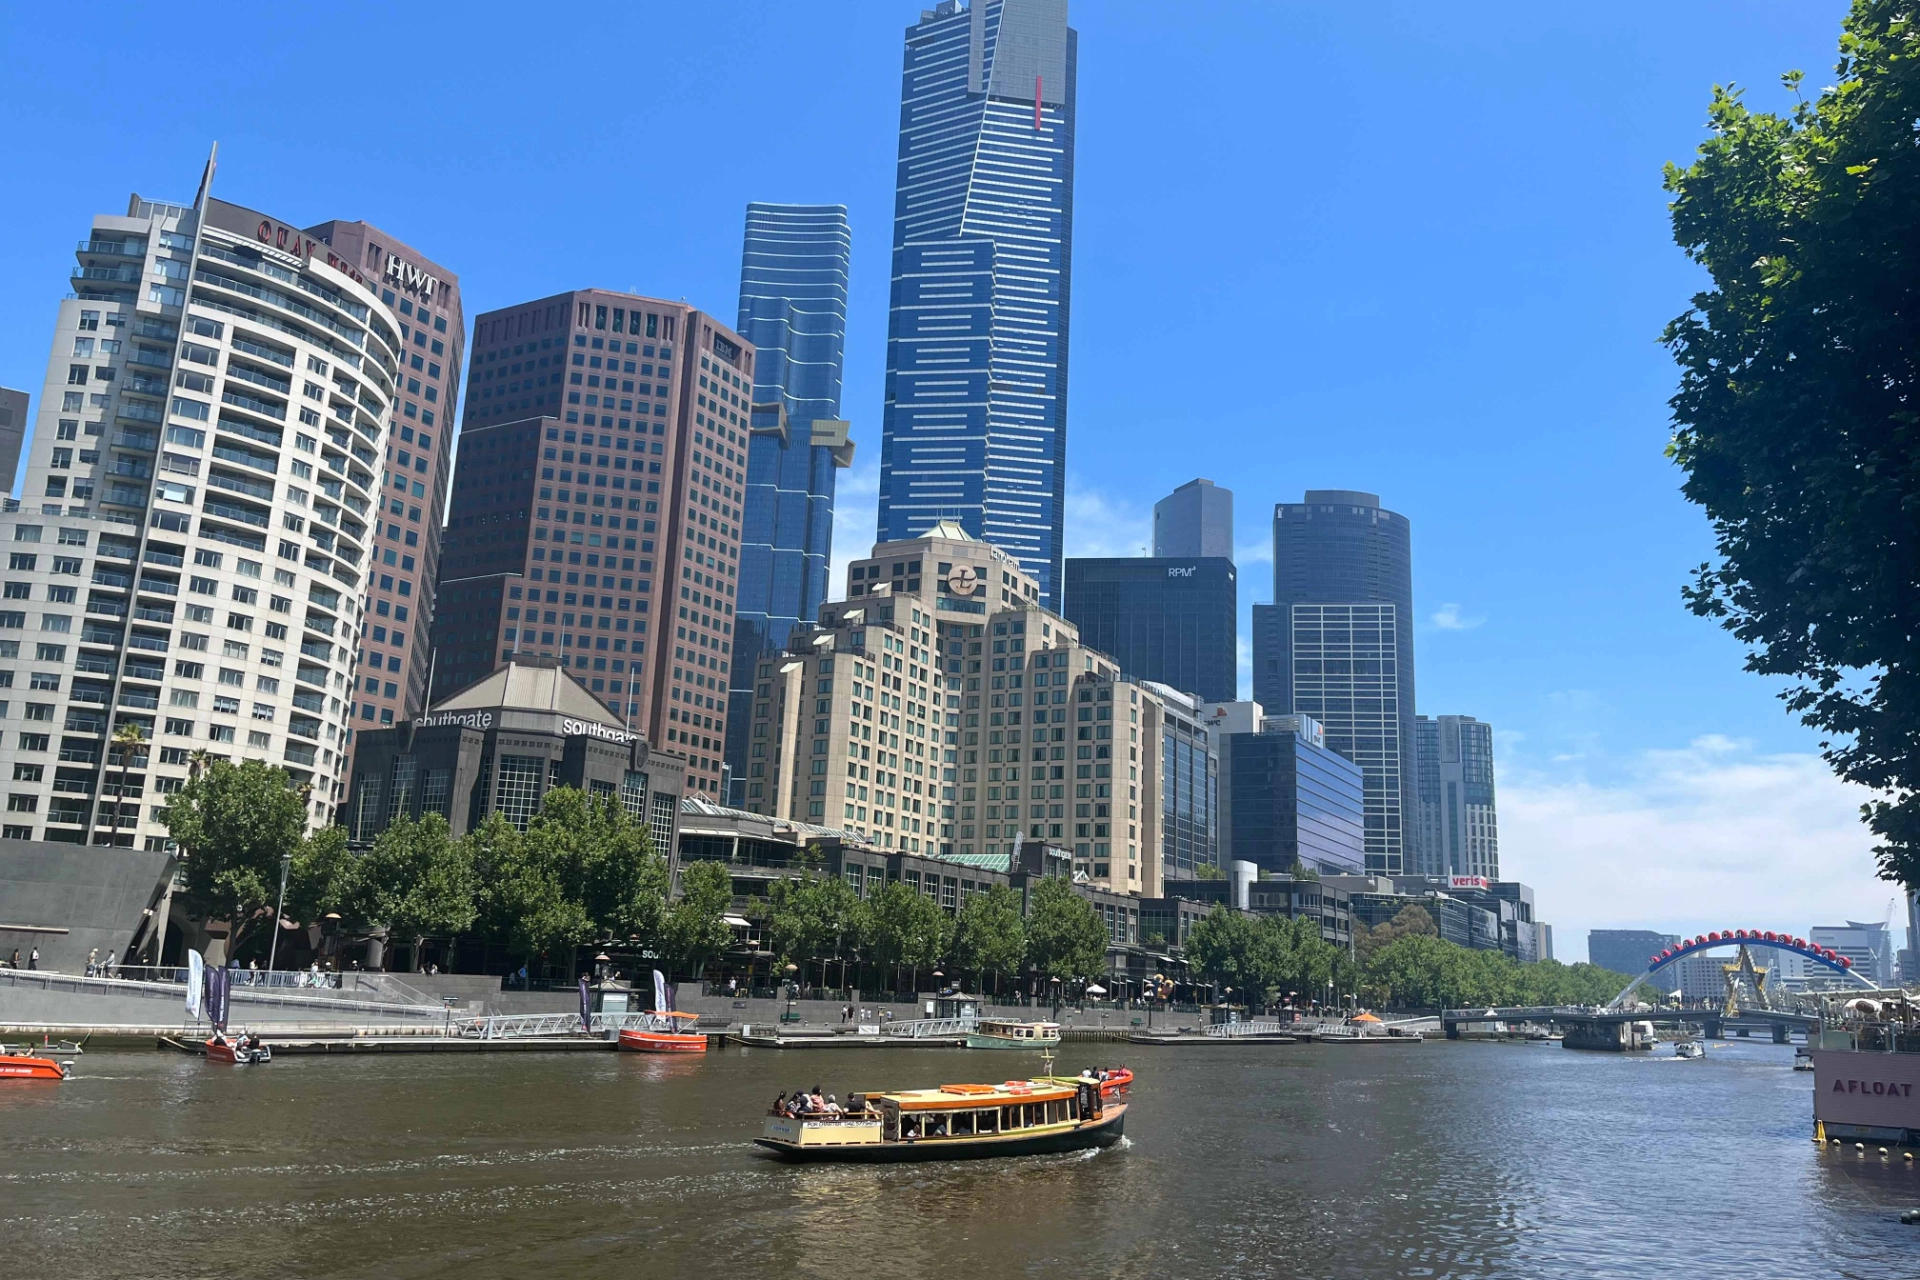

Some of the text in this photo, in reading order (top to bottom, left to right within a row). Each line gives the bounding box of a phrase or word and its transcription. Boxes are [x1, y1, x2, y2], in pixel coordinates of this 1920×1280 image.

[257, 220, 316, 258] QUAY
[386, 251, 438, 296] HWT
[715, 339, 733, 358] IBM
[1452, 875, 1480, 886] veris
[1648, 930, 1844, 967] MERRY CHRISTMAS
[1832, 1079, 1912, 1097] AFLOAT
